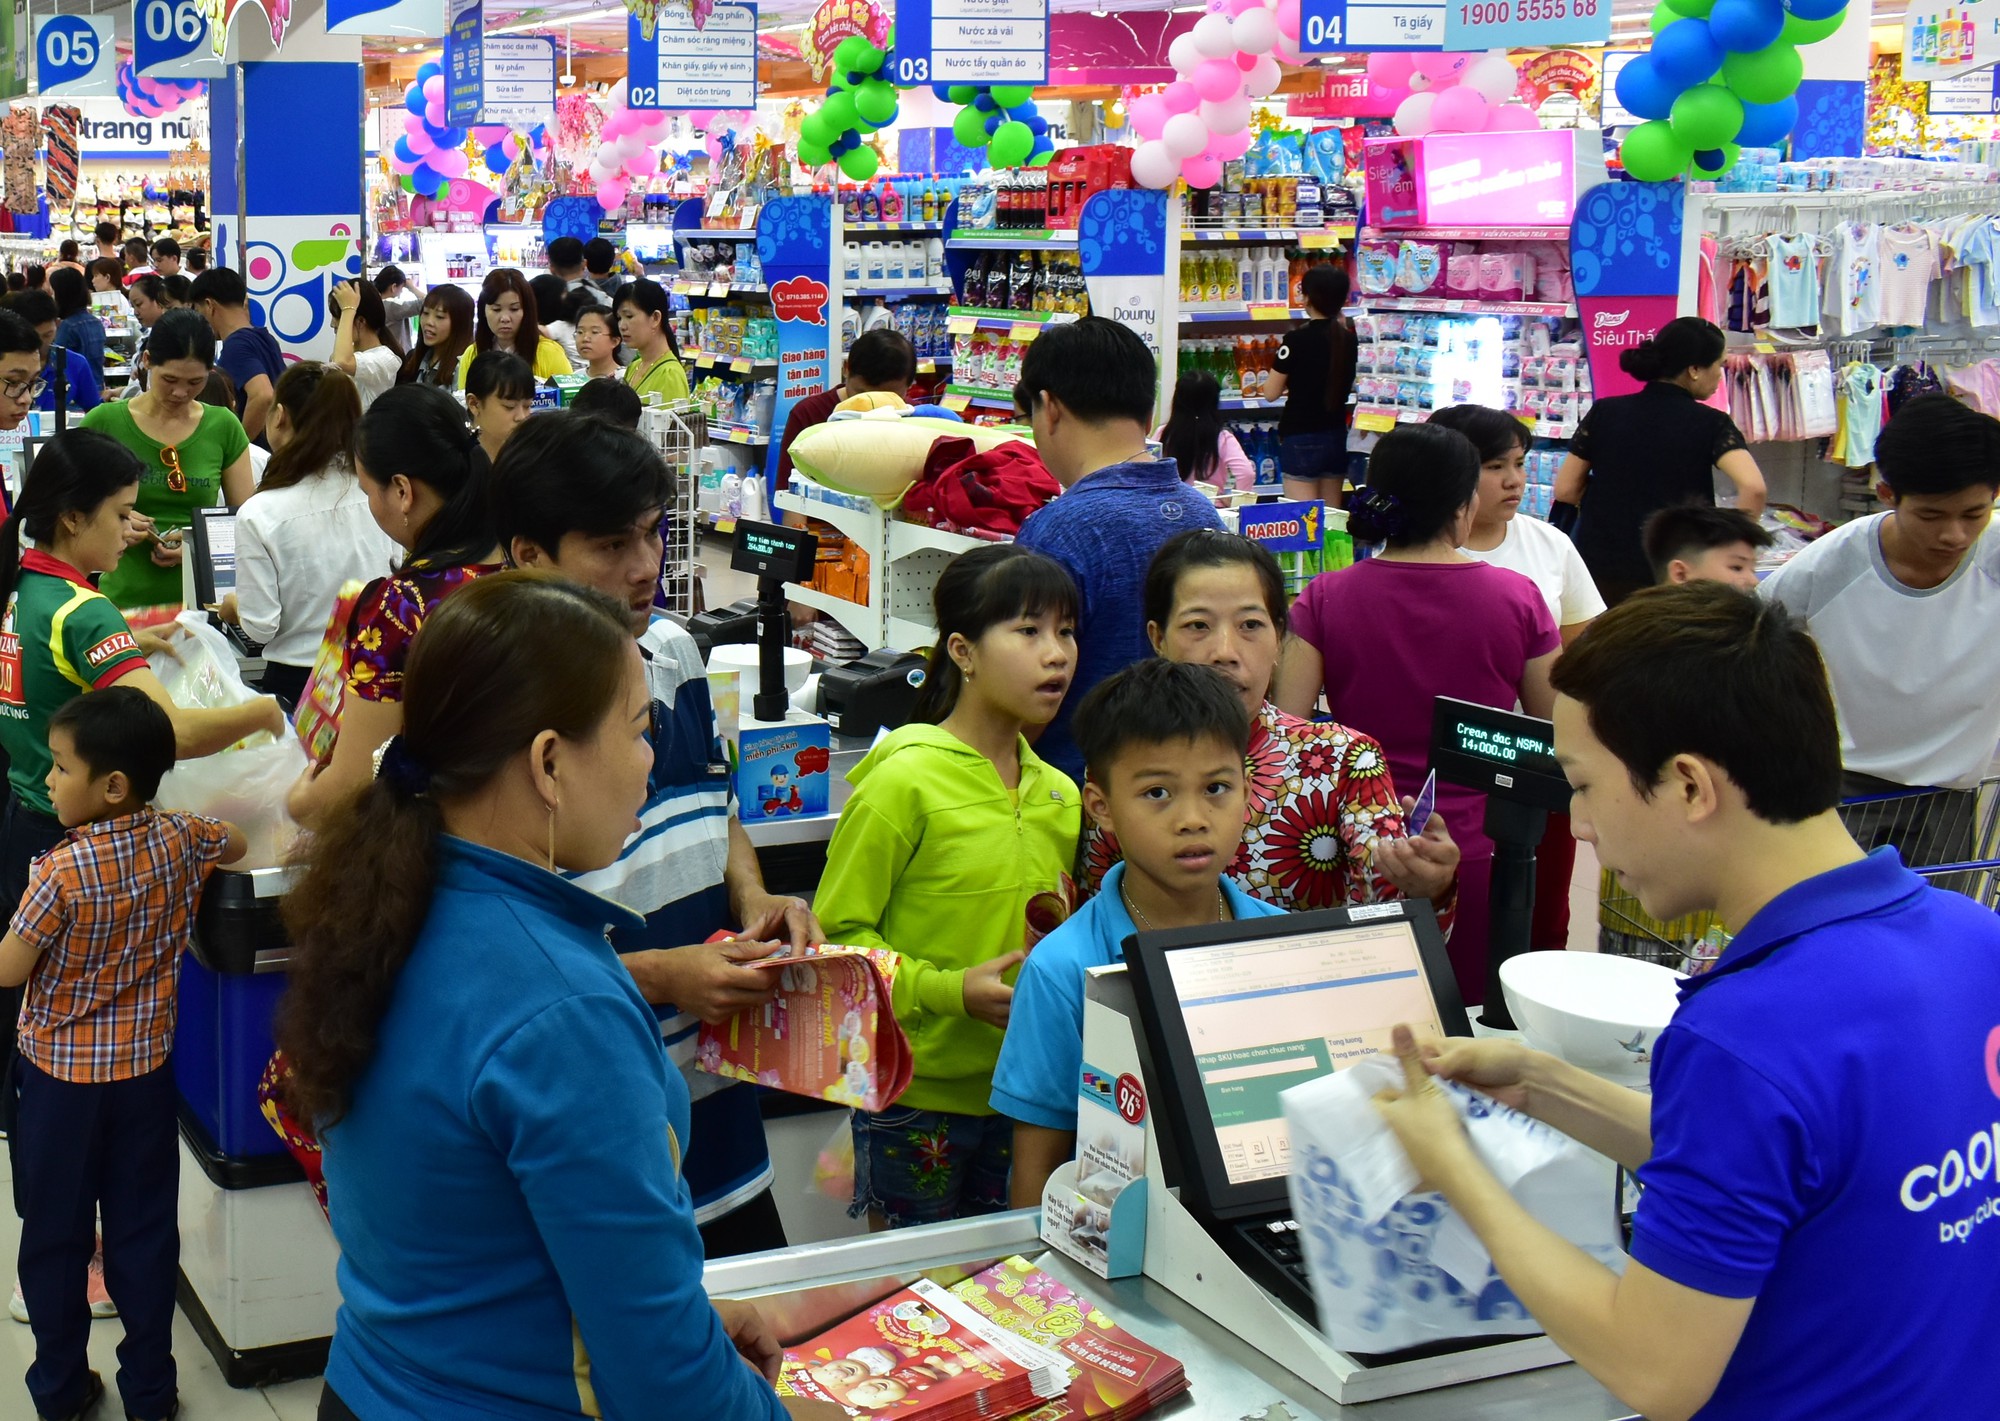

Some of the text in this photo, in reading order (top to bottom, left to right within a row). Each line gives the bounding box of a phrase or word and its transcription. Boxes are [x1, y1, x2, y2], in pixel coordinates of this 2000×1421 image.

[145, 0, 200, 42] 06
[1393, 14, 1433, 30] Tã giấy
[1460, 0, 1599, 26] 1900 5555 68
[959, 26, 1014, 35] Nước xả vải
[1307, 16, 1343, 45] 04
[45, 30, 94, 66] 05
[662, 35, 746, 46] Chăm sóc răng miệng
[662, 61, 682, 70] Khăn
[702, 60, 718, 72] giấy
[719, 62, 728, 70] vệ
[730, 61, 746, 70] sinh
[900, 58, 929, 82] 03
[945, 56, 1027, 69] Nước tẩy quần áo
[631, 87, 656, 106] 02
[677, 87, 731, 97] Diệt côn trùng
[1331, 78, 1369, 98] mãi
[83, 117, 152, 145] trang
[1369, 166, 1394, 181] Siêu
[1113, 307, 1155, 325] Downy
[1593, 328, 1657, 346] Siêu Thấ
[782, 349, 826, 363] Giao hàng
[787, 366, 820, 382] tận nhà
[808, 383, 823, 396] phí
[1246, 520, 1299, 539] HARIBO
[89, 634, 139, 664] MEIZA
[1457, 722, 1488, 740] Cream
[1492, 732, 1512, 746] dac
[1517, 737, 1543, 753] NSPN
[1462, 737, 1516, 760] 14,000.00
[1328, 1038, 1345, 1046] Tong
[1217, 1053, 1233, 1062] SKU
[1901, 1122, 2000, 1212] CO.O
